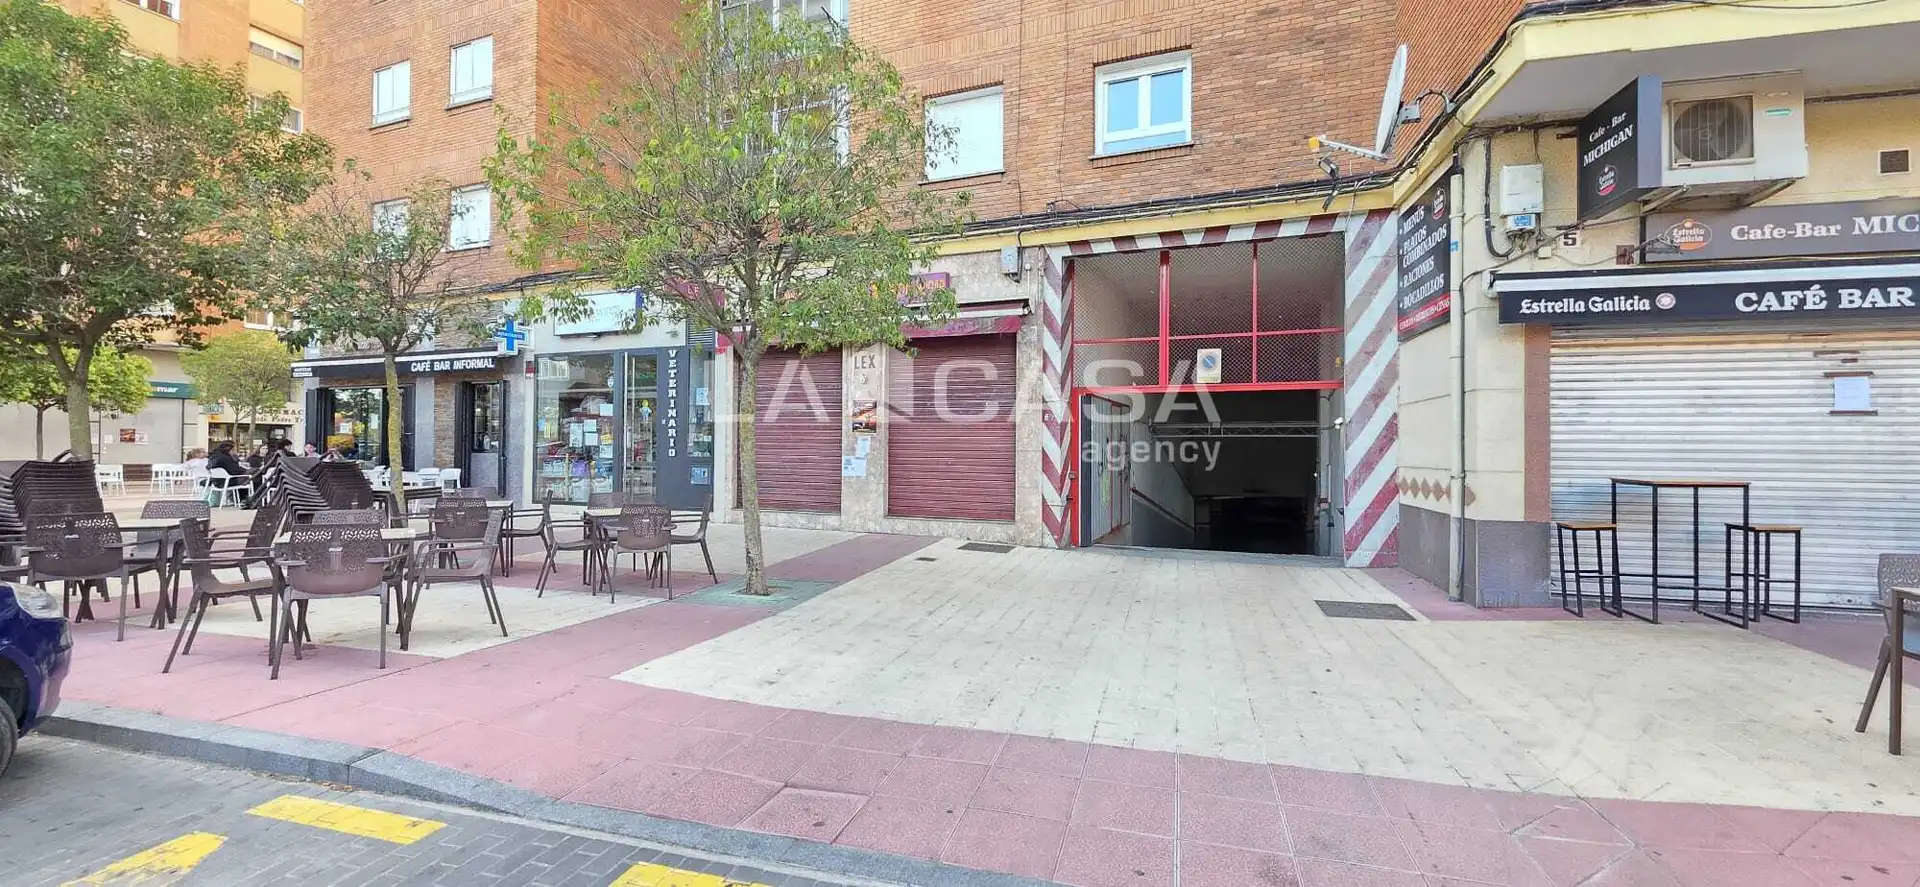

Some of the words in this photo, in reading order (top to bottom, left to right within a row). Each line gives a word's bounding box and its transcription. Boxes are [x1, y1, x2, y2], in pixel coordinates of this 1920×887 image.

[1589, 126, 1605, 142] Cafe
[1611, 112, 1627, 127] Bar
[1583, 124, 1634, 167] MICHIGAN
[1403, 224, 1427, 255] PLATOS
[1403, 223, 1447, 268] COMBINADOS
[1563, 232, 1577, 246] 5
[1672, 227, 1705, 237] Estrella
[1731, 221, 1842, 241] Cafe-Bar
[1403, 256, 1435, 288] RACIONES
[1403, 273, 1445, 310] BOCADILLOS
[1519, 297, 1585, 314] Estrella
[1588, 295, 1651, 312] Galicia
[1735, 284, 1828, 313] CAFÉ
[1837, 287, 1916, 309] BAR
[411, 360, 431, 372] CAFÉ
[433, 361, 451, 371] BAR
[453, 358, 495, 370] INFORMAL
[854, 355, 876, 369] LEX
[667, 349, 678, 457] VETERINARIO
